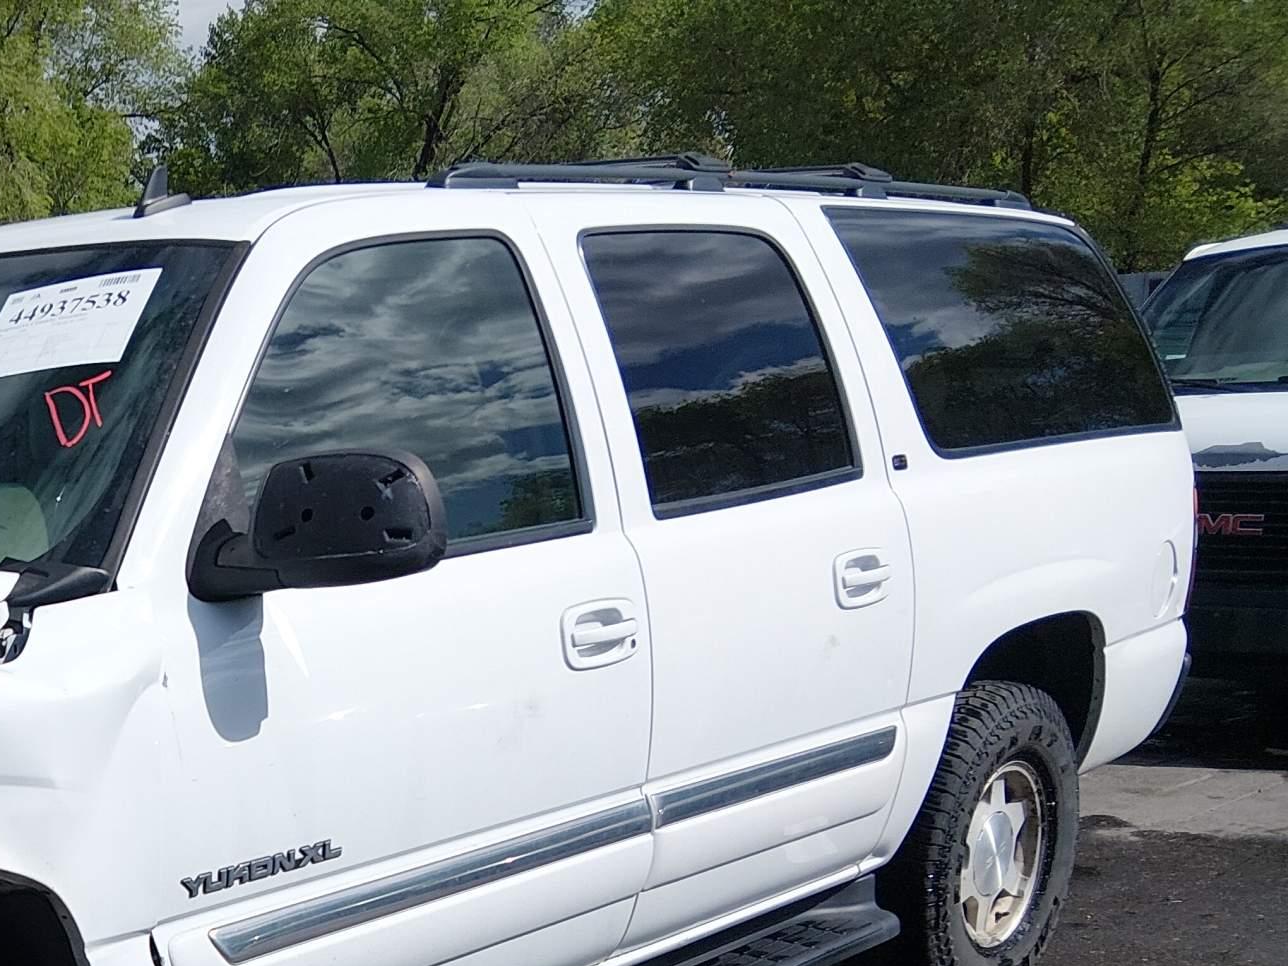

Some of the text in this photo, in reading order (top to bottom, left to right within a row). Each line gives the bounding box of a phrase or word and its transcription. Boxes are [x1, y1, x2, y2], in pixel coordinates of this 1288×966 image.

[9, 290, 130, 325] 44937538
[44, 369, 113, 448] DT
[1197, 512, 1265, 536] MC
